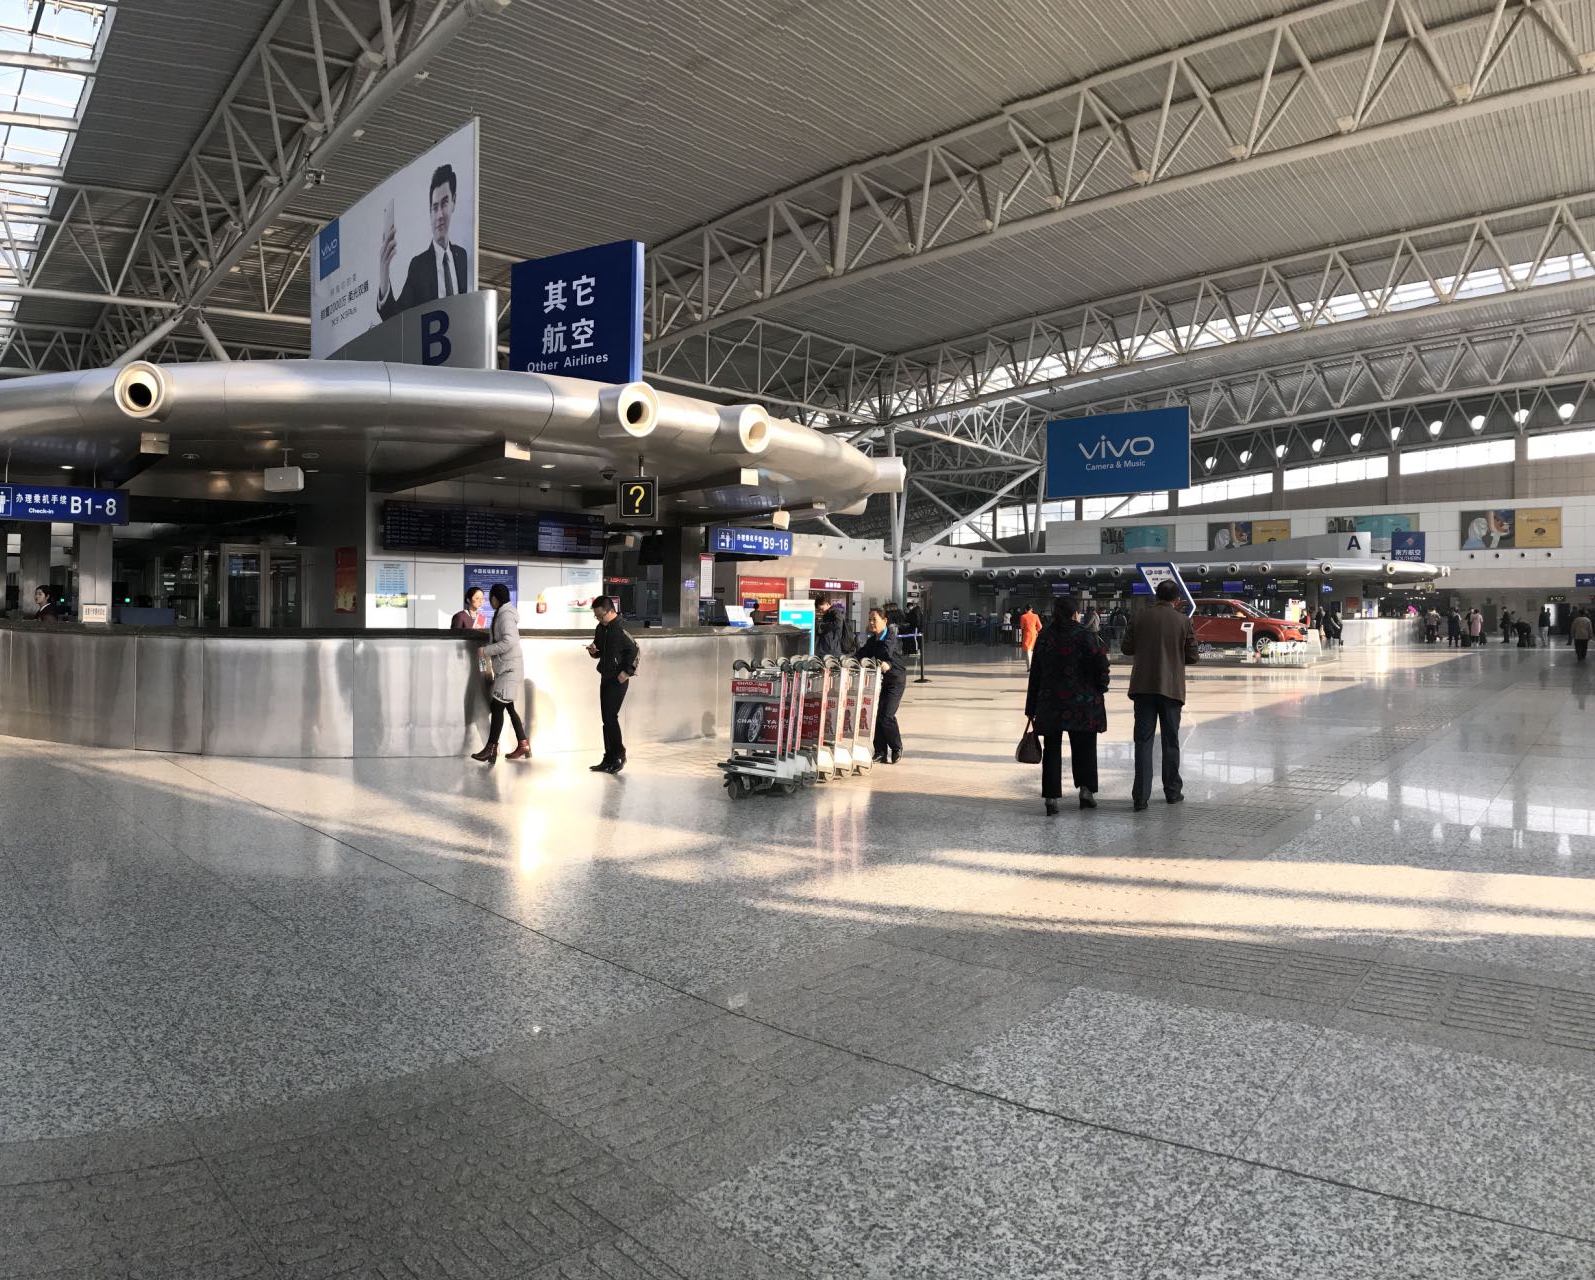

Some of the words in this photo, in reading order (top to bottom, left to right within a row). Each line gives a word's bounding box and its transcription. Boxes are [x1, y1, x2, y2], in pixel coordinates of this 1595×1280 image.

[321, 238, 338, 257] vivo
[543, 274, 596, 314] 其它
[420, 309, 451, 366] B
[541, 318, 596, 356] 航空
[527, 360, 559, 374] Other
[564, 351, 609, 368] Airlines
[1078, 435, 1155, 460] vivo
[1085, 462, 1114, 471] Camera
[1116, 461, 1122, 469] &
[1124, 459, 1146, 468] Music
[15, 492, 68, 505] 办理乘机手续
[70, 496, 117, 516] B1-8
[763, 536, 789, 551] B9-16
[1347, 535, 1362, 551] A
[1394, 549, 1422, 557] 南方航空
